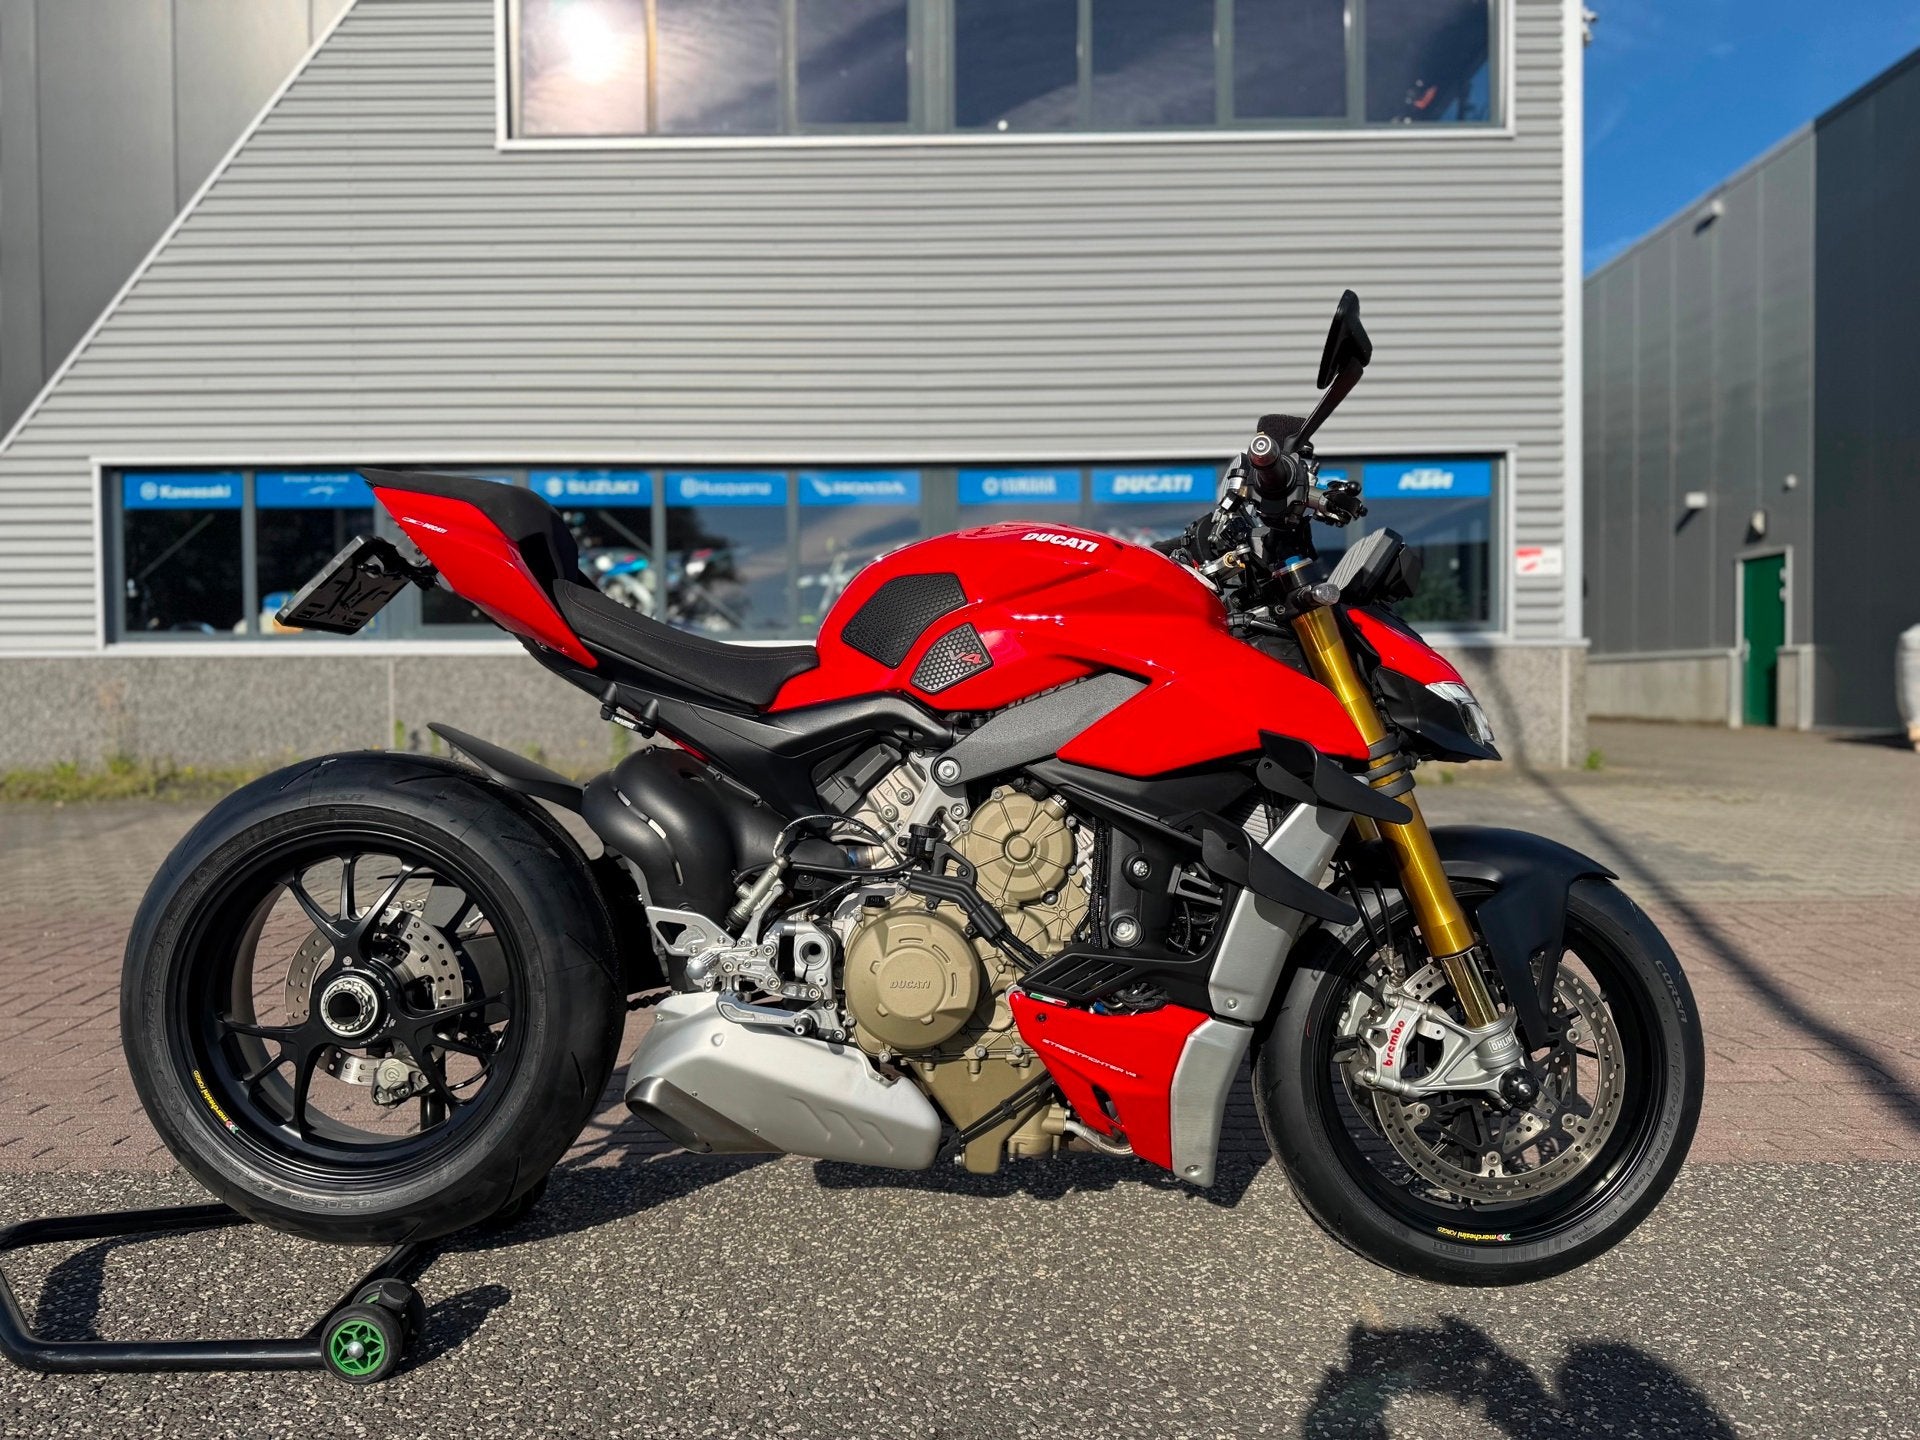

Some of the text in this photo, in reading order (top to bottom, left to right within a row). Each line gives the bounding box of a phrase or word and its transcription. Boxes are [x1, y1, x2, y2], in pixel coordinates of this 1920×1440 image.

[1000, 477, 1056, 494] YAMAHA
[1113, 475, 1192, 493] DUCATI
[1398, 468, 1453, 490] KTM
[159, 485, 231, 498] Kawasaki
[566, 480, 639, 494] SUZUKI
[832, 481, 905, 495] HONDA
[1021, 532, 1099, 553] DUCATI
[948, 650, 982, 664] V4
[889, 980, 931, 989] DUCATI
[1383, 1020, 1405, 1067] brembo
